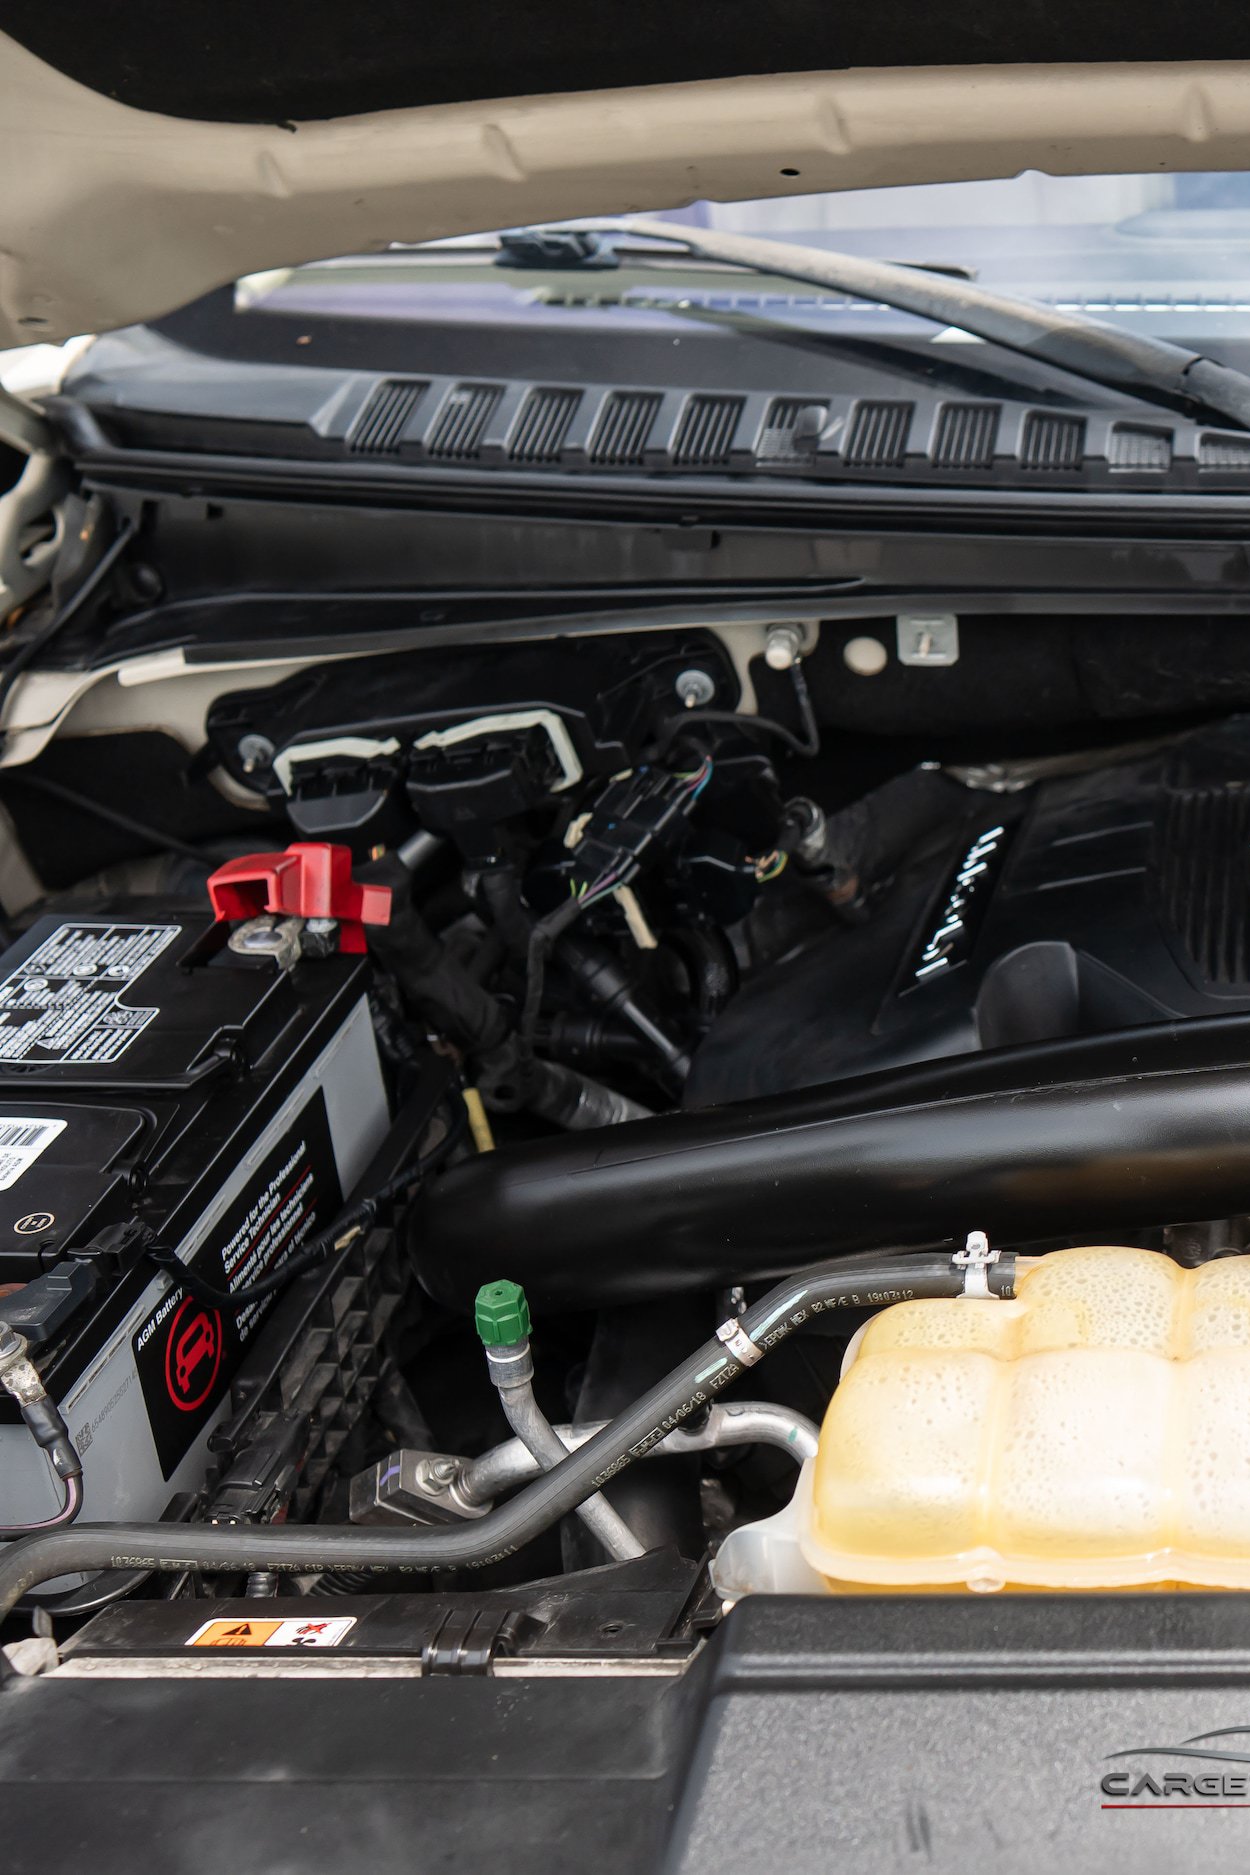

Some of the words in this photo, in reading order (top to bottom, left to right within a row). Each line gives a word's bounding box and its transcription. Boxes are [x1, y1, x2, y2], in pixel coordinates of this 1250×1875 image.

[222, 1217, 250, 1261] Powered
[249, 1205, 259, 1223] for
[258, 1192, 270, 1210] the
[269, 1140, 306, 1195] Professional
[224, 1237, 250, 1274] Service
[248, 1193, 280, 1240] Technician
[256, 1232, 270, 1260] pour
[270, 1218, 281, 1236] les
[137, 1318, 157, 1351] AGM
[156, 1287, 183, 1324] Battery
